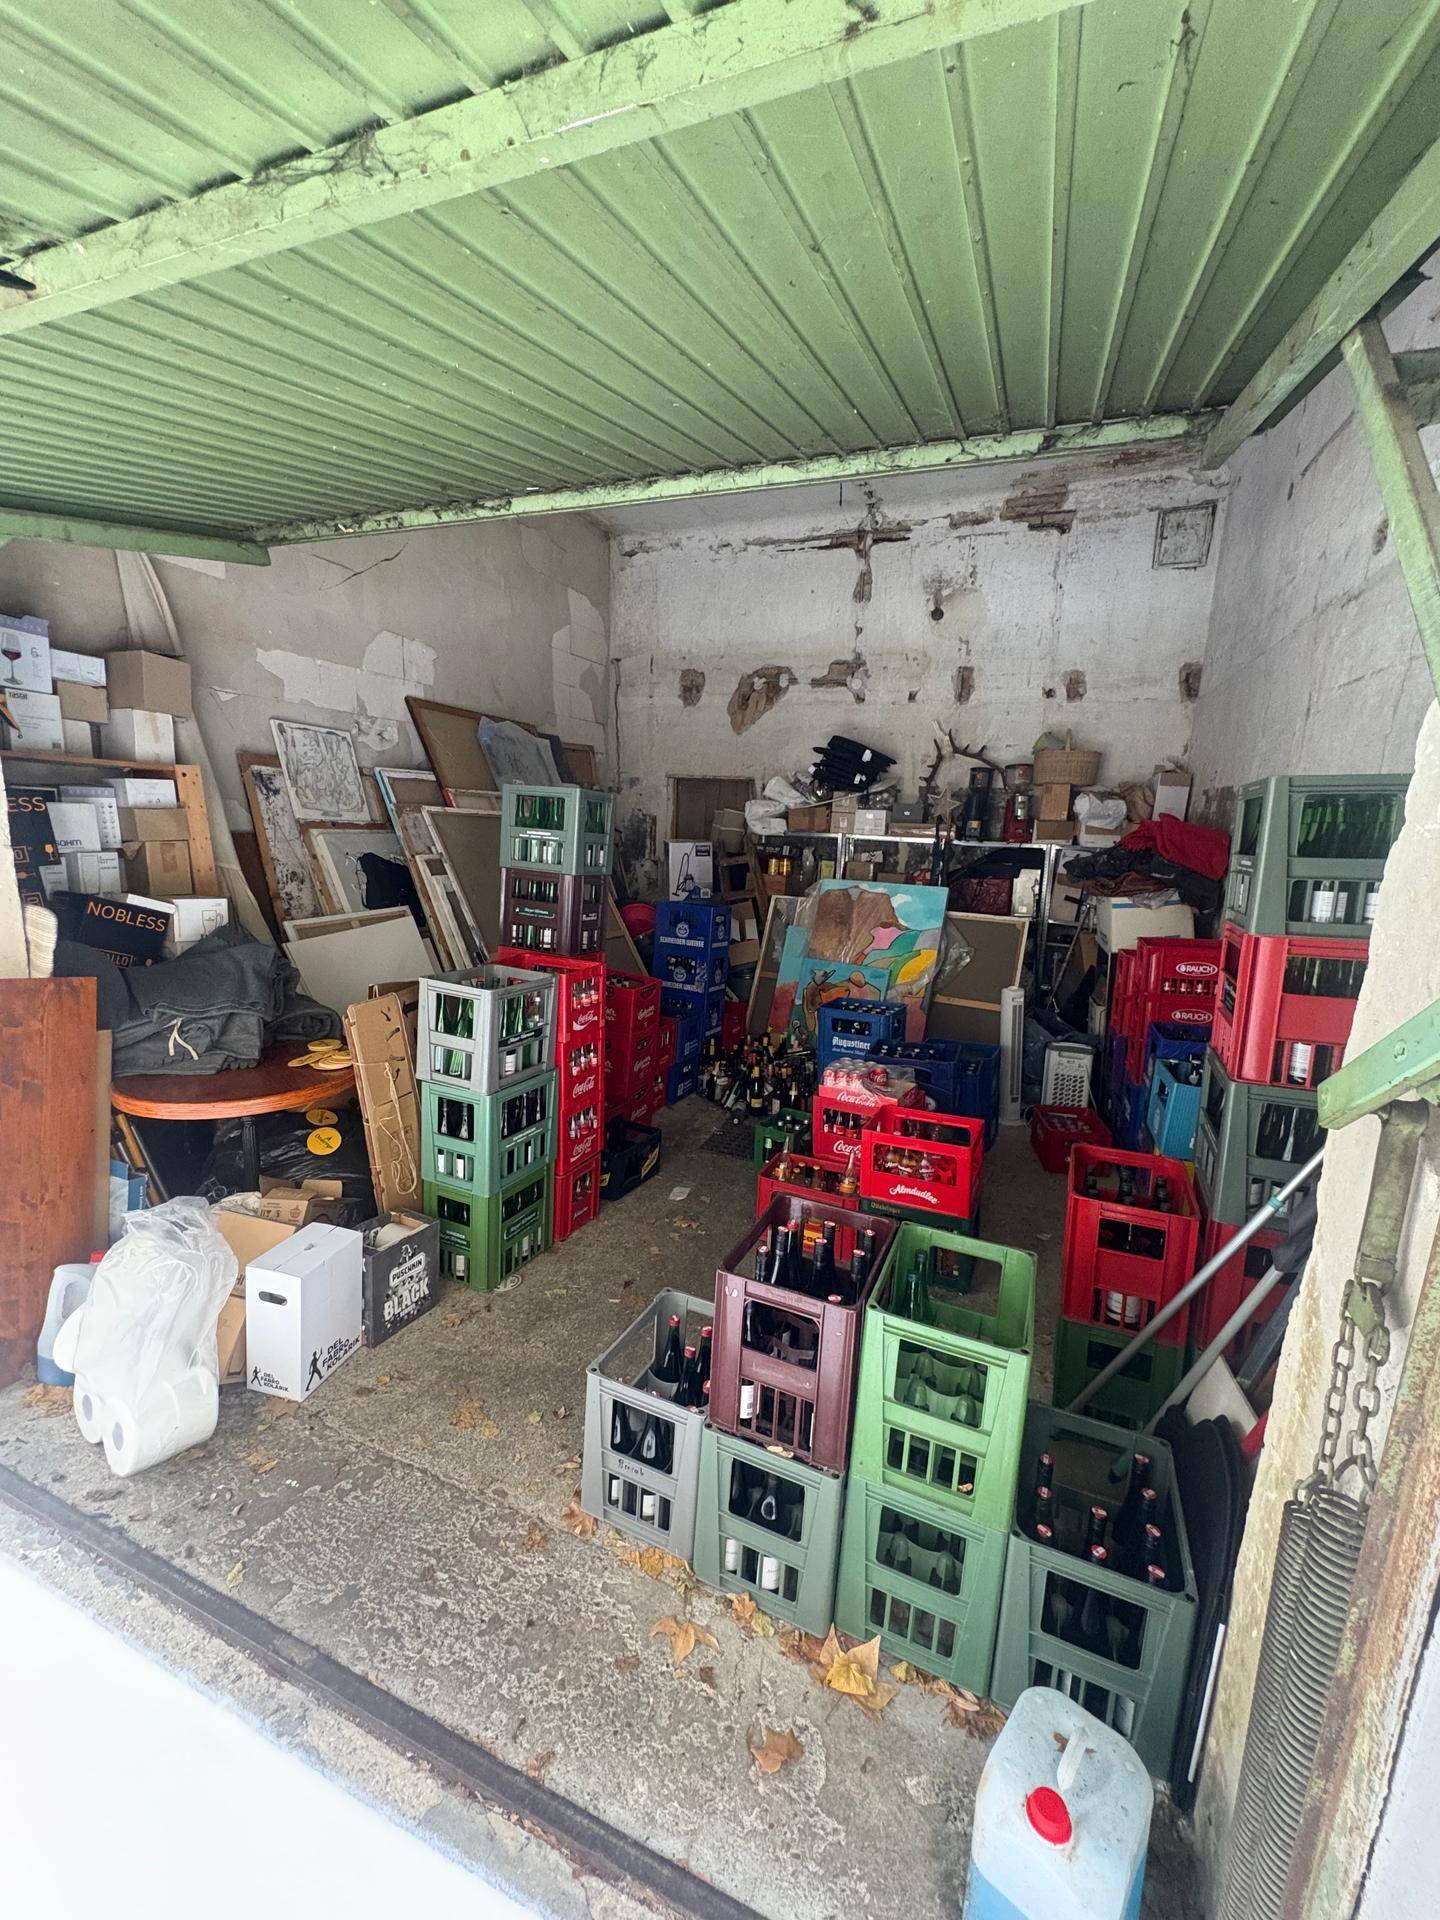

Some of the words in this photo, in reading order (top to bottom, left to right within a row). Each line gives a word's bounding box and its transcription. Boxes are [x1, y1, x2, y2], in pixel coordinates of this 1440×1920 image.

[8, 796, 46, 812] ESS
[87, 901, 167, 932] NOBLESS
[1186, 964, 1213, 973] RAUCH
[1181, 1012, 1208, 1020] RAUCH
[832, 1036, 871, 1050] Augustiner
[889, 1184, 938, 1205] Almdudler
[384, 1276, 429, 1321] BLACK
[322, 1338, 350, 1367] FABRO
[326, 1335, 361, 1371] KOLARIK
[327, 1337, 343, 1354] DEL
